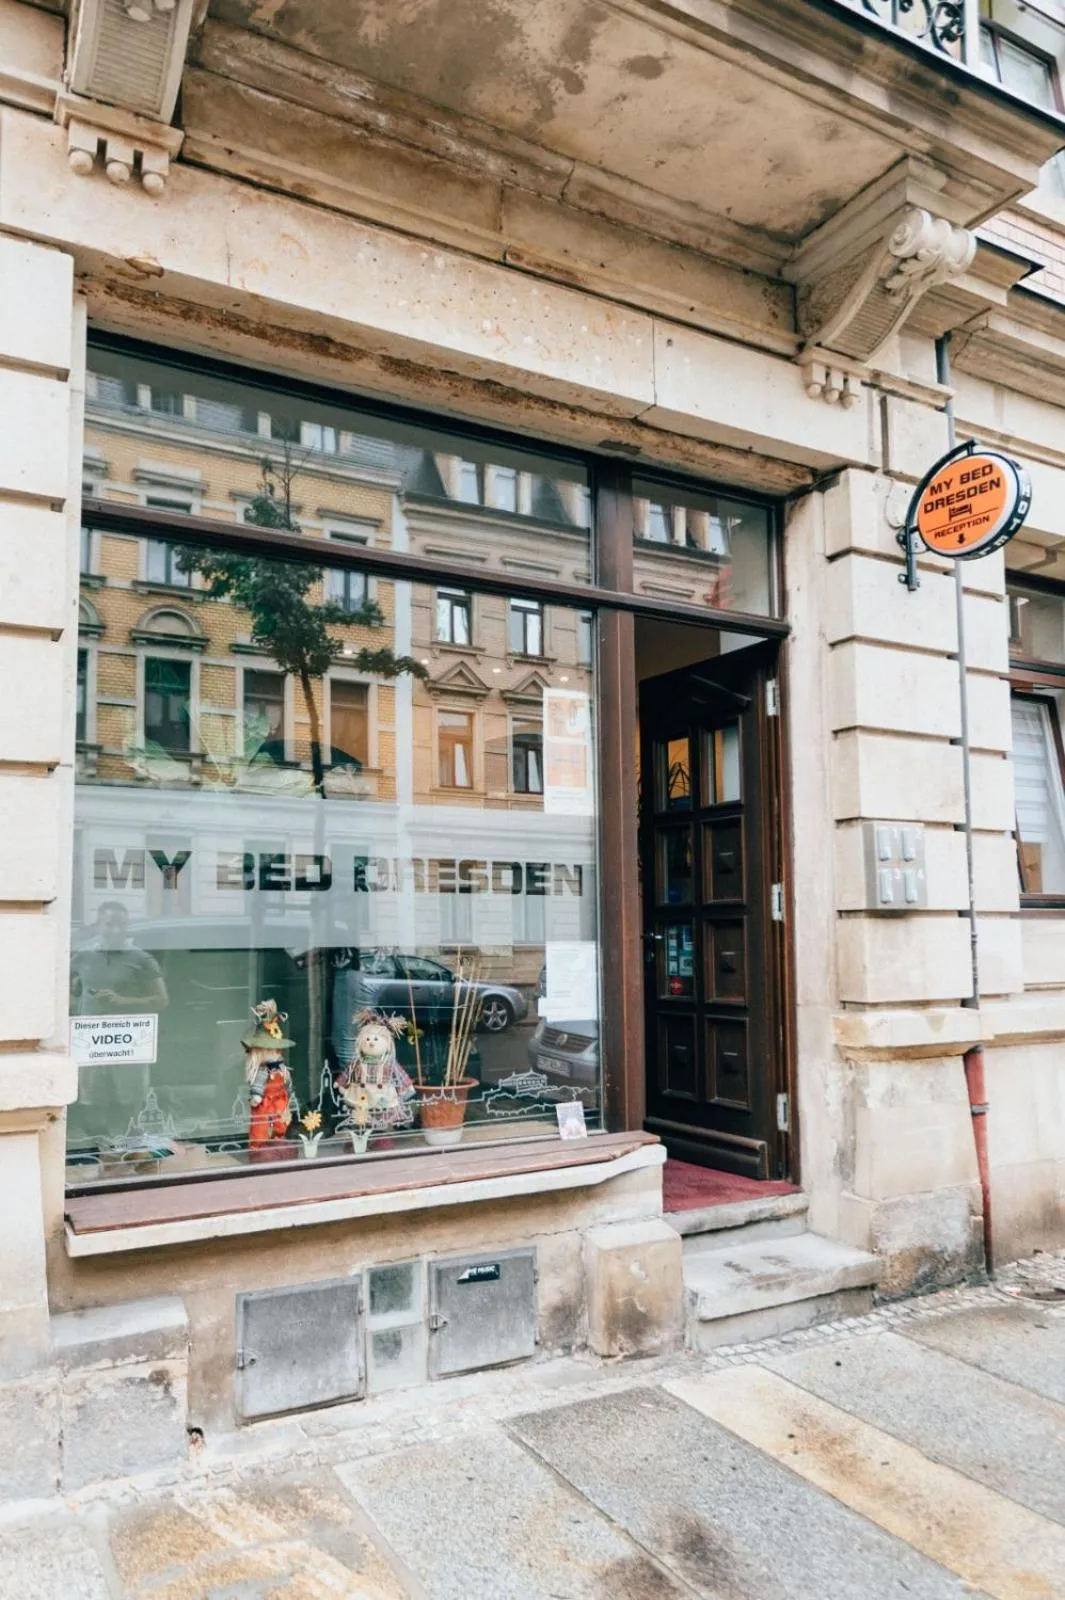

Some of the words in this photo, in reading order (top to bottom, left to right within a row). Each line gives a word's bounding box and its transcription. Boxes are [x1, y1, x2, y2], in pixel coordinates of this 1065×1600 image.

[929, 478, 953, 497] MY
[959, 463, 993, 485] BED
[923, 477, 1001, 514] DRESDEN
[933, 514, 990, 539] RECEPTION
[94, 849, 193, 889] MY
[216, 851, 333, 892] BED
[353, 855, 583, 897] DRESDEN
[74, 1022, 99, 1030] Dieser
[101, 1020, 131, 1029] Bereich
[132, 1020, 151, 1028] wird
[91, 1034, 133, 1045] VIDEO
